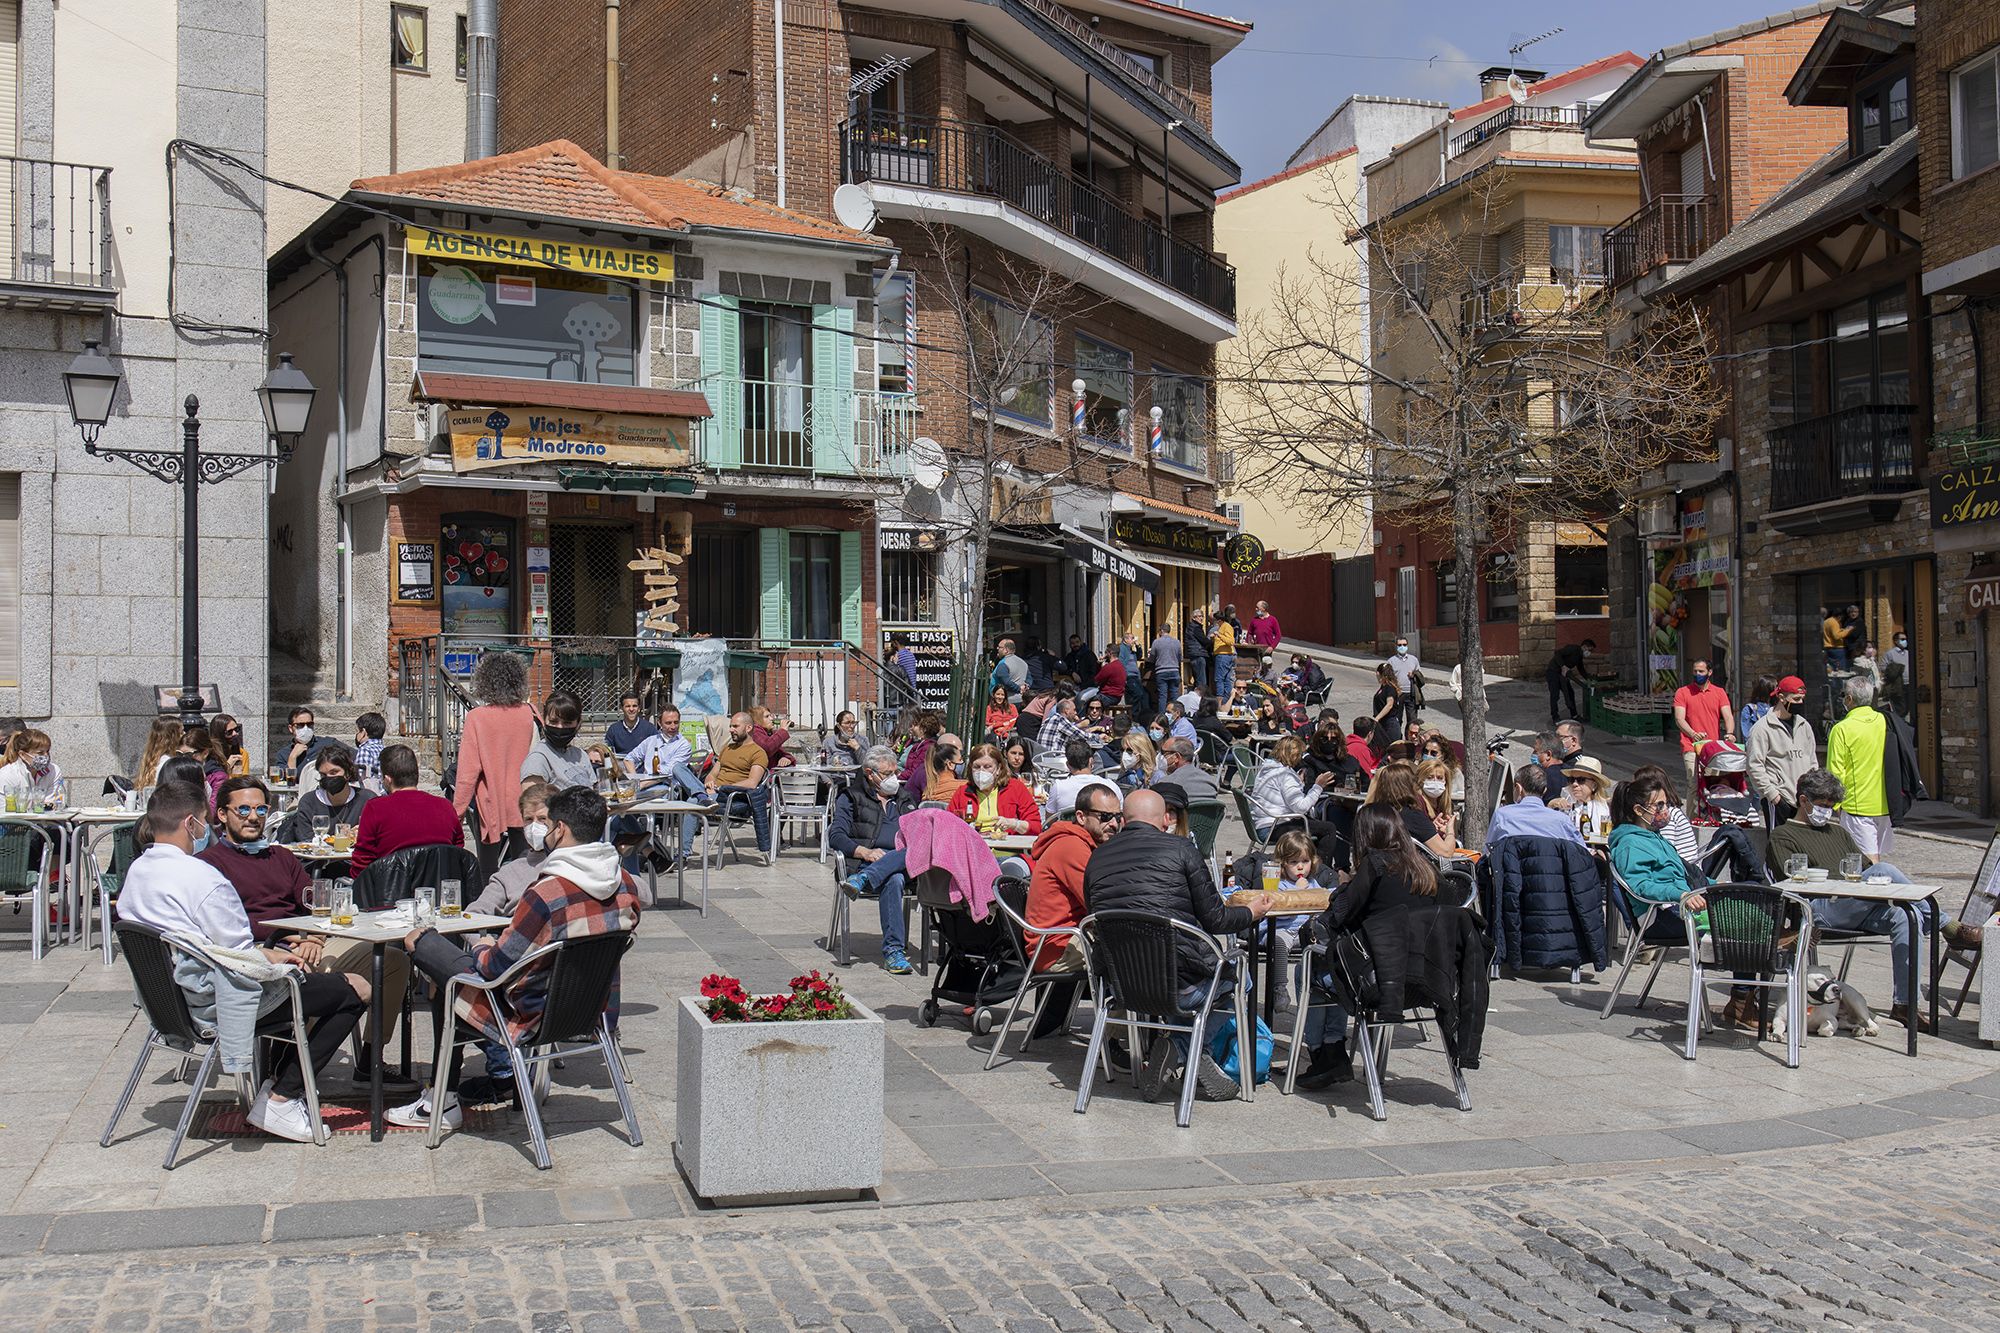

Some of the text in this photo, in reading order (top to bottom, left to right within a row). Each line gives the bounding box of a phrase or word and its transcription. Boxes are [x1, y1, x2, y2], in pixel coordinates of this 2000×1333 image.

[425, 231, 660, 275] AGENCIA DE VIAJES
[429, 288, 480, 300] Guadarrama
[452, 416, 482, 426] CICMA 663
[528, 416, 582, 435] Viajes
[617, 425, 662, 435] Sierra del
[617, 433, 667, 443] Guadarrama
[527, 436, 607, 456] Madroño
[1940, 466, 2000, 491] CALZ
[1115, 519, 1134, 539] Café
[1142, 525, 1167, 545] Mesón
[400, 543, 433, 554] VISITAS
[1092, 548, 1107, 570] BAR
[1109, 556, 1119, 575] EL
[1119, 561, 1137, 582] PASO
[1241, 556, 1262, 573] Chivo
[922, 632, 948, 642] PASO
[916, 674, 951, 682] BURGUESAS
